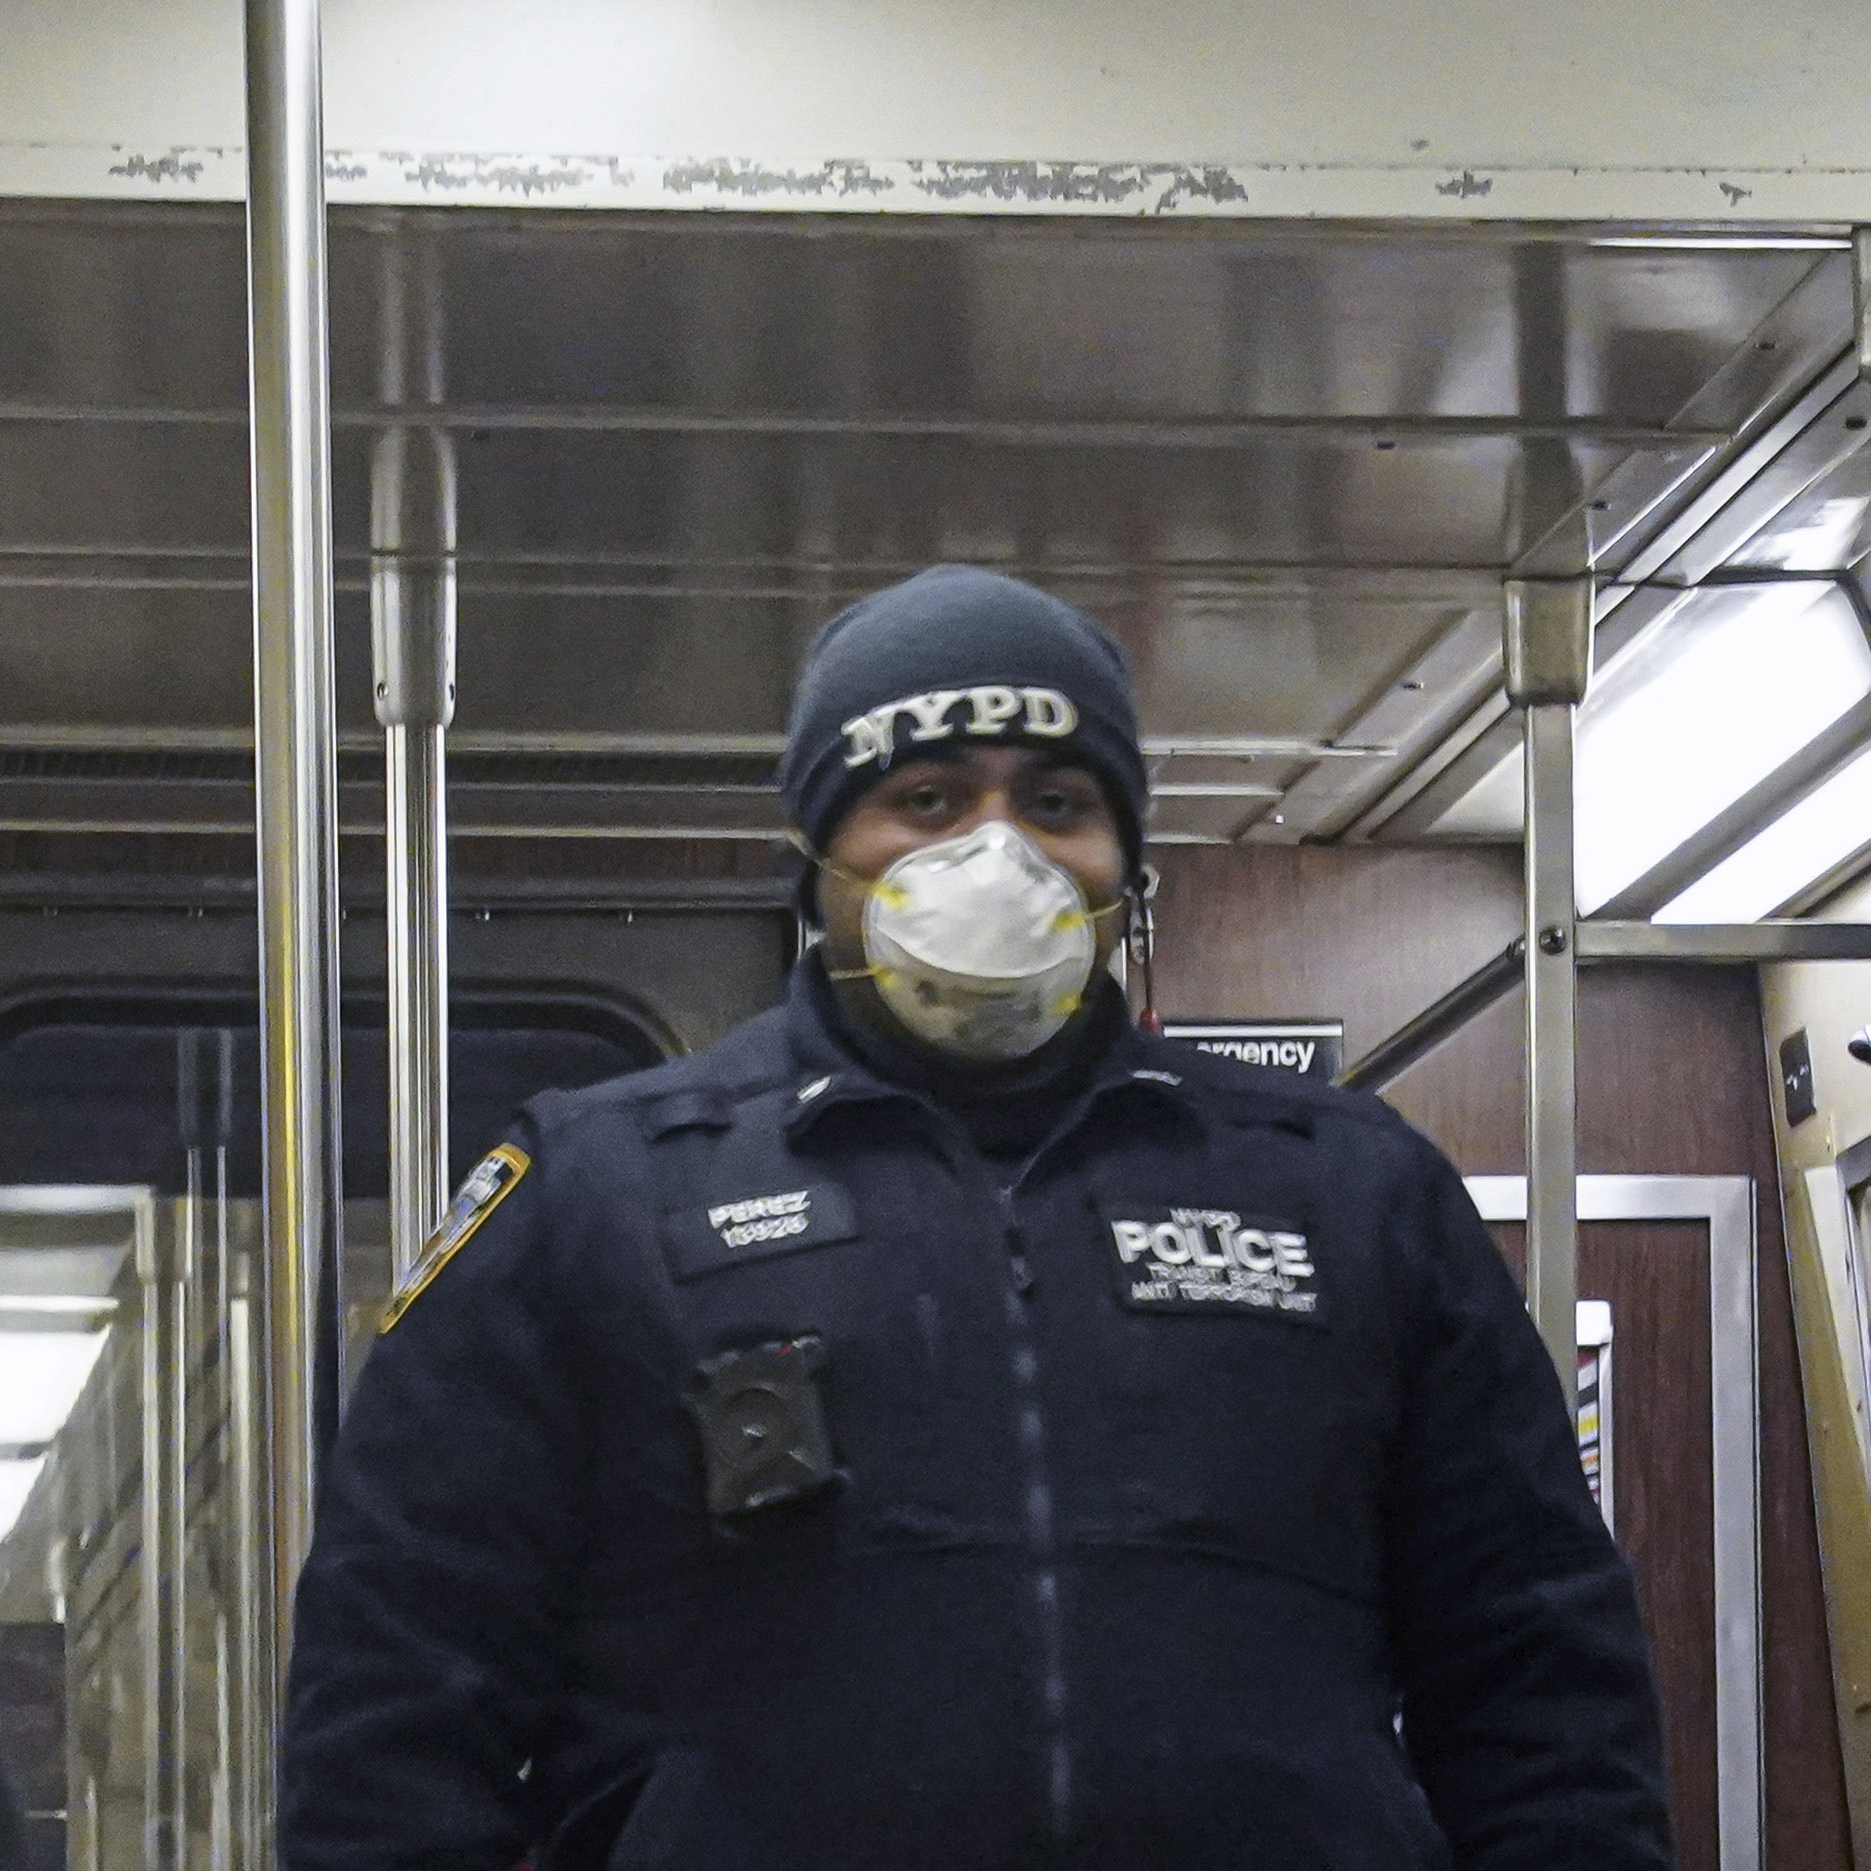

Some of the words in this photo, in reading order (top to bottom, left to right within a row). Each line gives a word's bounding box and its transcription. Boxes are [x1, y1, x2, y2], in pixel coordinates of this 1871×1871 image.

[840, 685, 1079, 770] NYPD
[708, 1190, 811, 1229] PEREZ
[1110, 1219, 1316, 1278] POLICE
